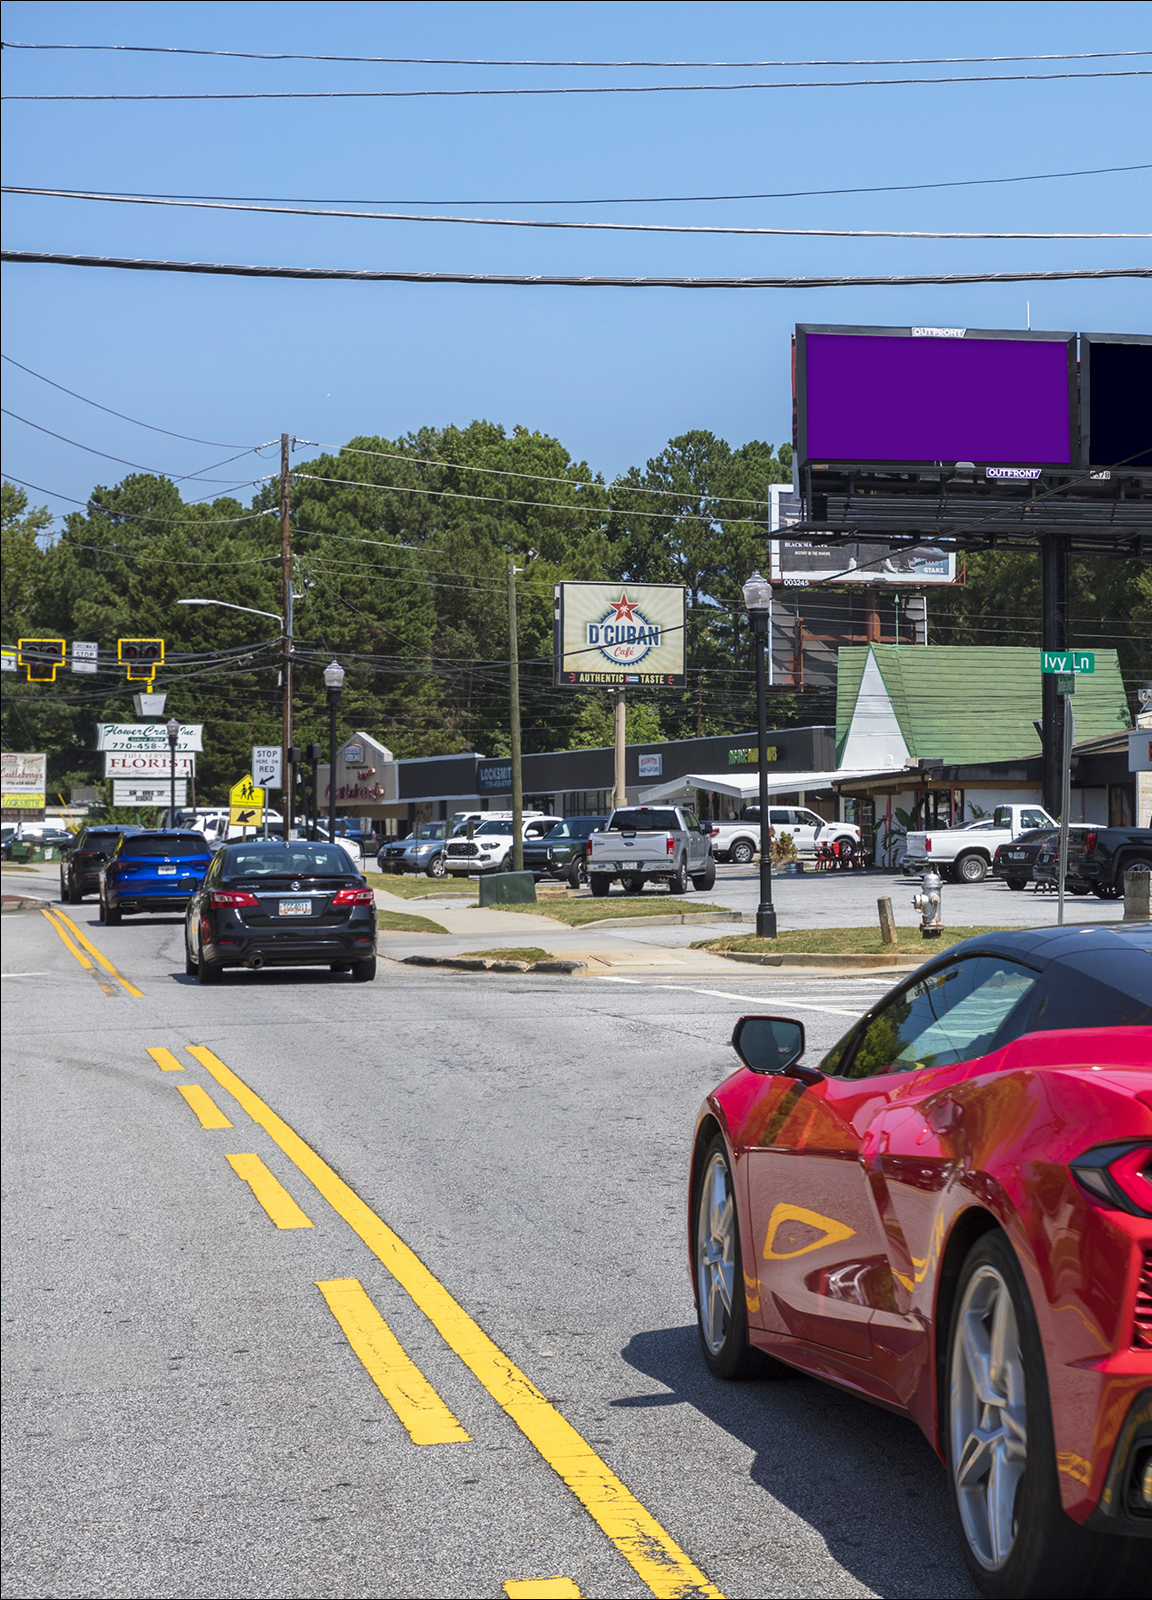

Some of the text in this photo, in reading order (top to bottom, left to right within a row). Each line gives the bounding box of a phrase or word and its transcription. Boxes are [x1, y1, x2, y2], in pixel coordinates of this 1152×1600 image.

[913, 328, 964, 337] OUTFRONT
[987, 468, 1039, 478] OUTFRONT
[614, 646, 635, 658] Café
[1045, 653, 1089, 671] Ivy Ln
[580, 673, 664, 684] AUTHENTIC TASTE
[257, 750, 278, 758] STOP
[110, 759, 190, 768] FLORIST
[480, 766, 512, 781] LOCKSMIT
